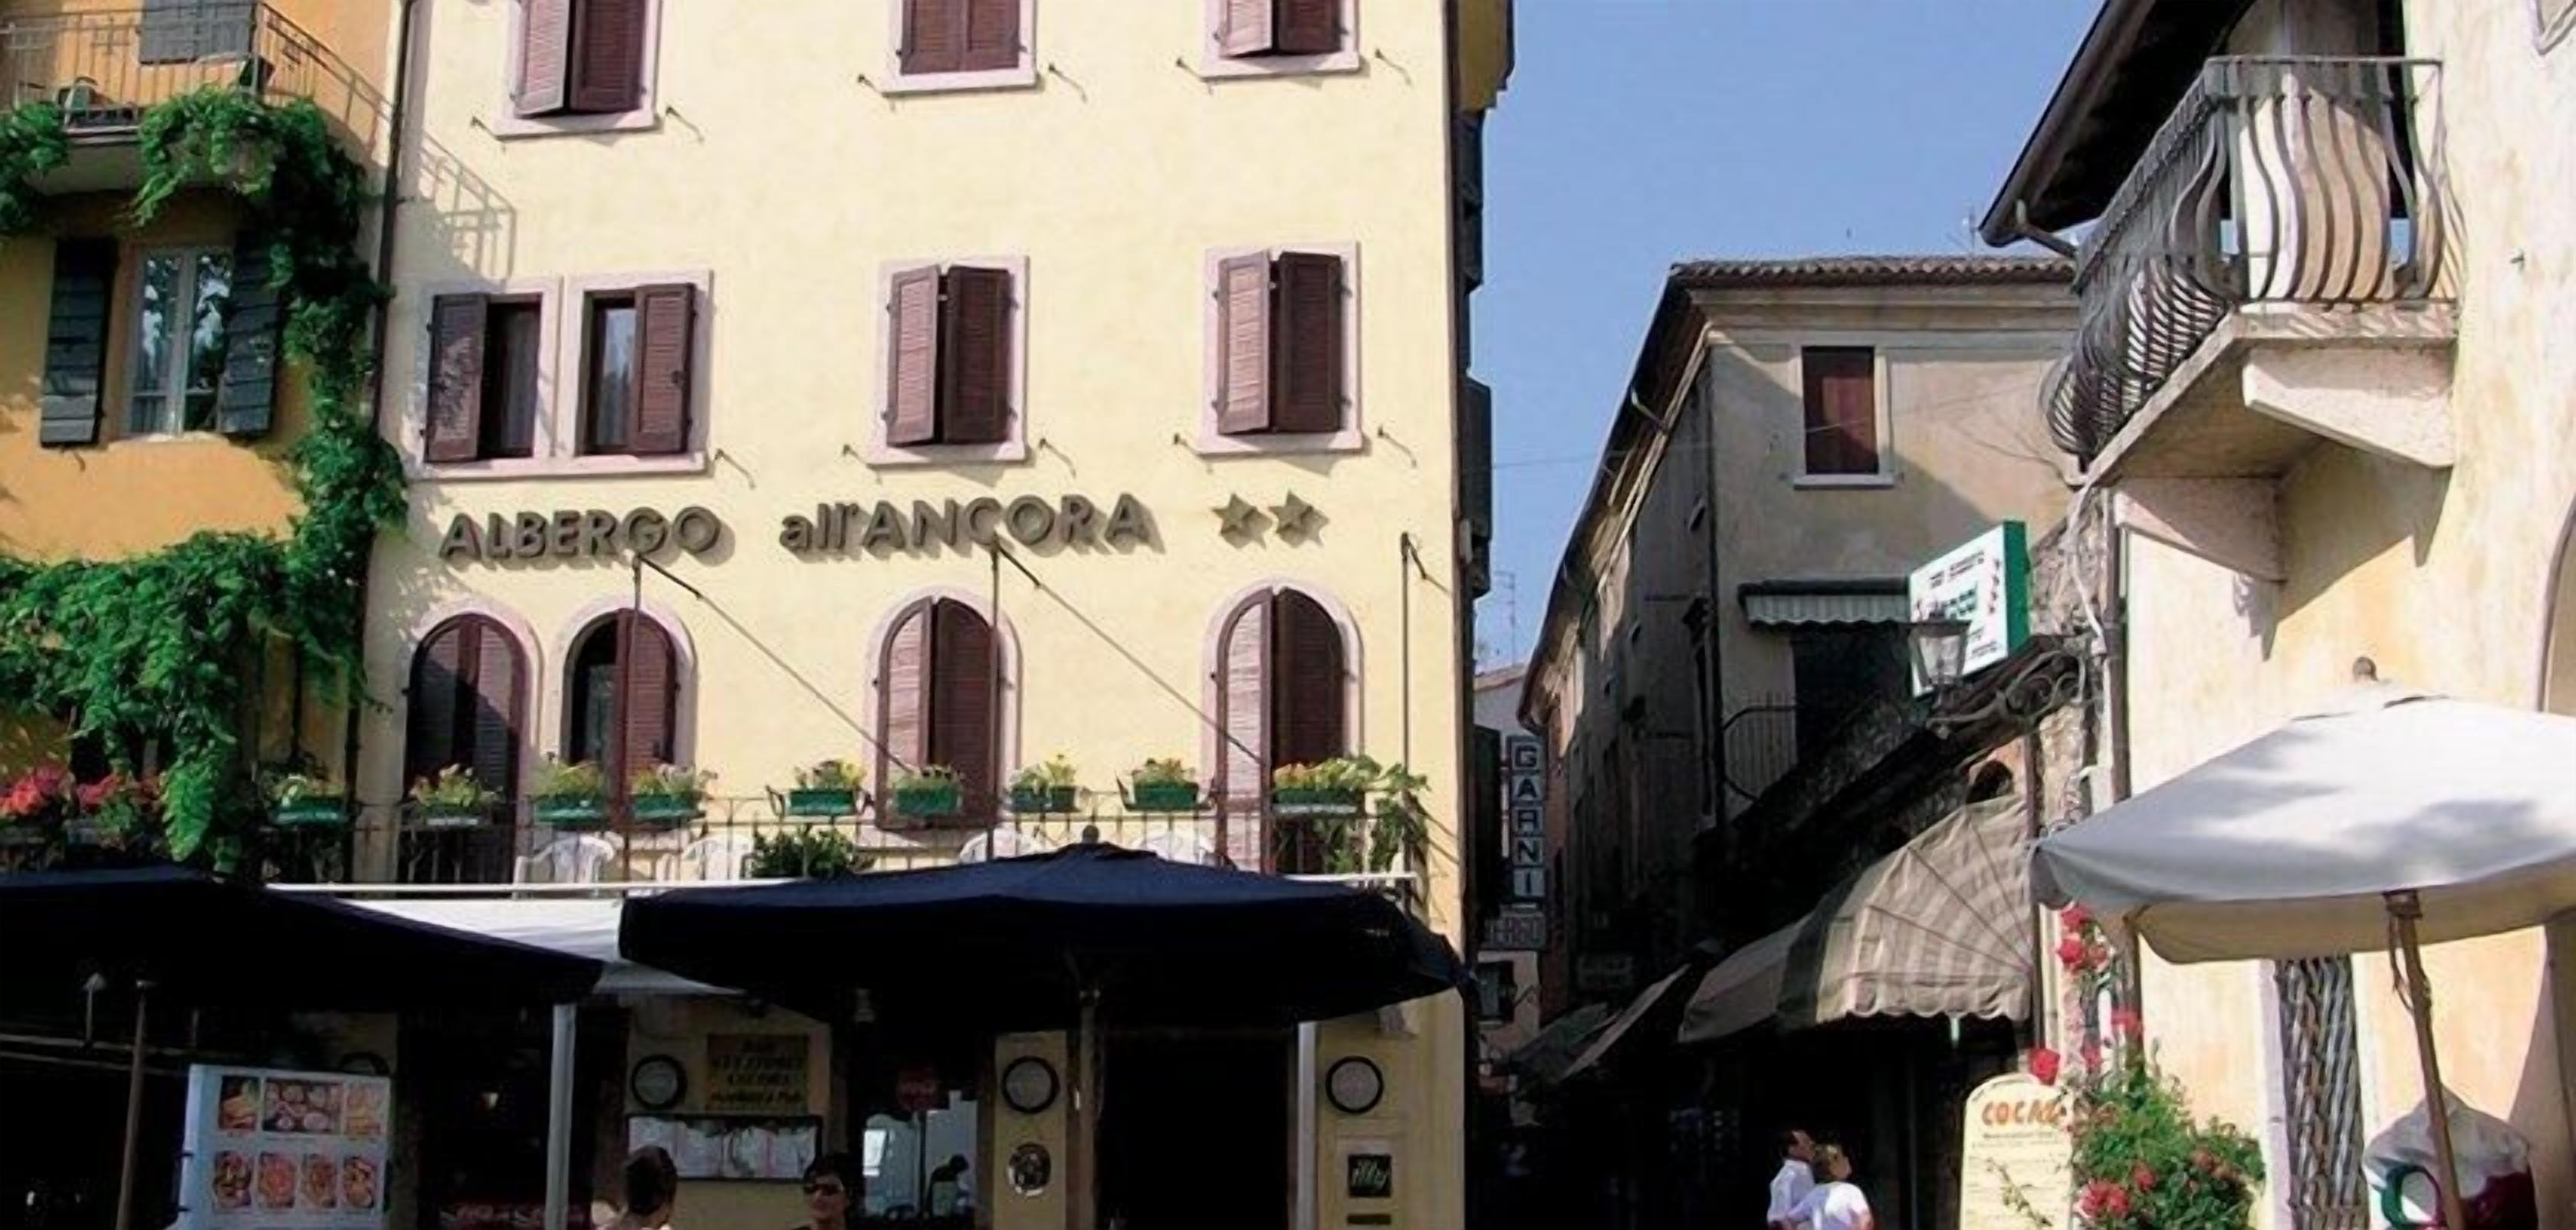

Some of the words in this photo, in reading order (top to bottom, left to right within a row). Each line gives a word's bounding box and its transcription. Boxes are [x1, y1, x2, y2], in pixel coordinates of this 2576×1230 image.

[439, 506, 722, 560] ALBERGO
[779, 493, 1152, 550] all'ANCORA
[1514, 745, 1539, 896] GARNI
